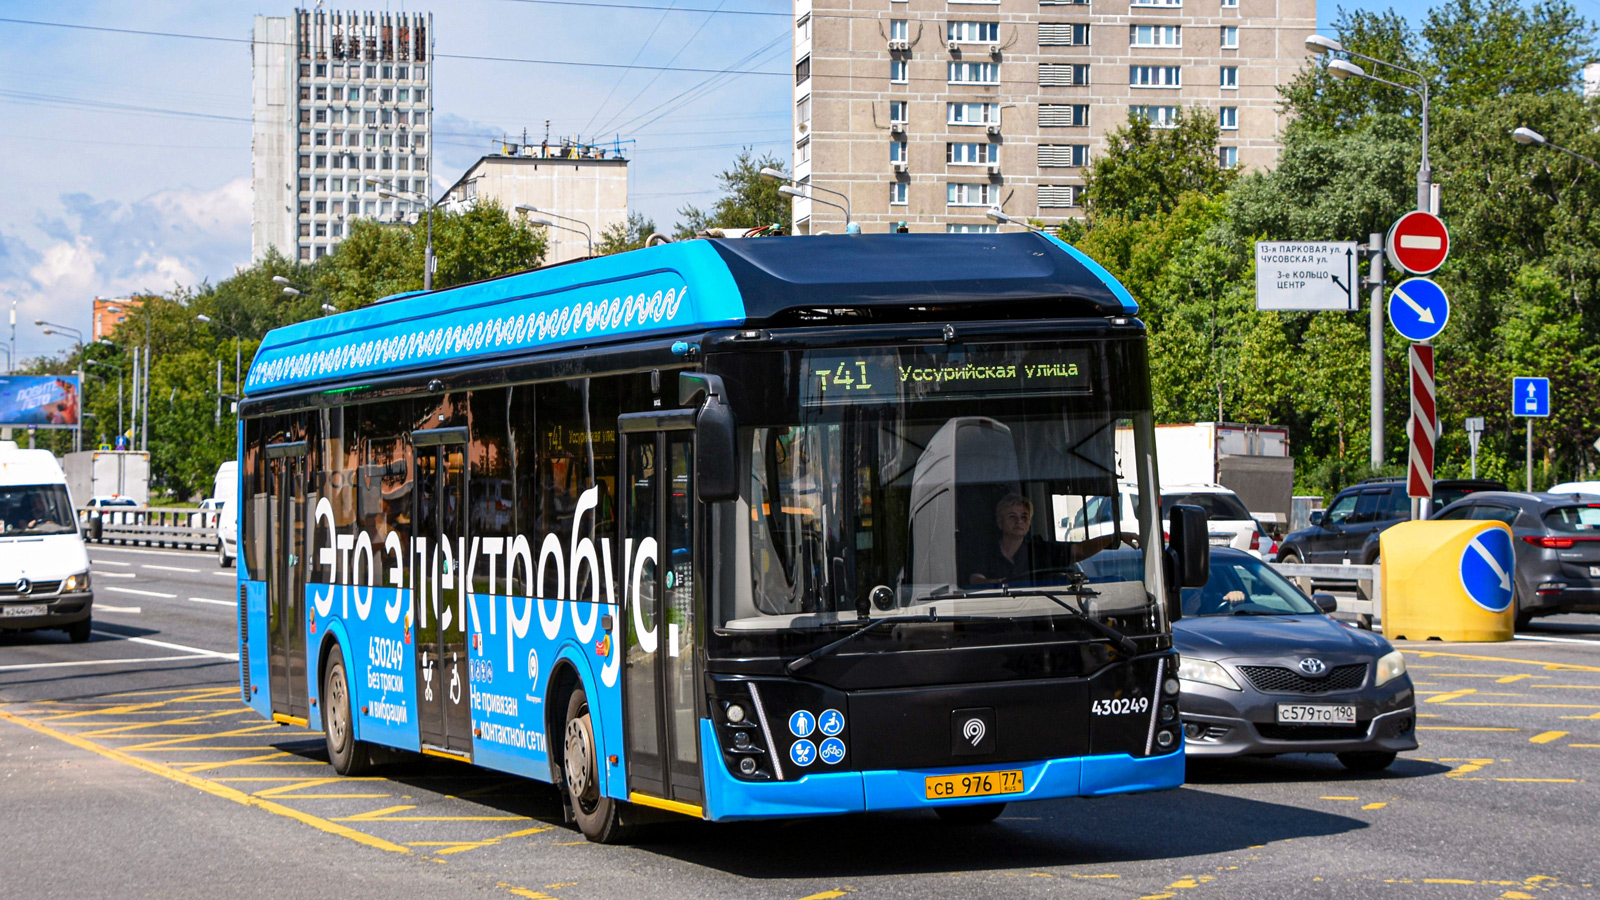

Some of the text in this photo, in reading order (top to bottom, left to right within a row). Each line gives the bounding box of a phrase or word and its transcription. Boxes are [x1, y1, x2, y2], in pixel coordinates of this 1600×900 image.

[1261, 245, 1341, 255] 13-я ПАРКОВАЯ ул.
[1261, 255, 1328, 265] ЧУСОВСКАЯ ул.
[1277, 271, 1328, 280] 3-е КОЛЬЦО
[1277, 281, 1306, 290] ЦЕНТР
[899, 364, 1016, 382] Уссурийская
[1025, 363, 1079, 379] улица
[314, 496, 374, 621] Это
[368, 636, 404, 671] 430249
[367, 665, 404, 695] Без тряски
[369, 696, 408, 726] и вибраций
[470, 684, 482, 711] Не
[482, 693, 518, 718] привязан
[1092, 697, 1149, 716] 430249
[481, 721, 526, 750] контактной
[527, 729, 547, 753] сети
[961, 775, 992, 794] 976
[1001, 773, 1018, 786] 77
